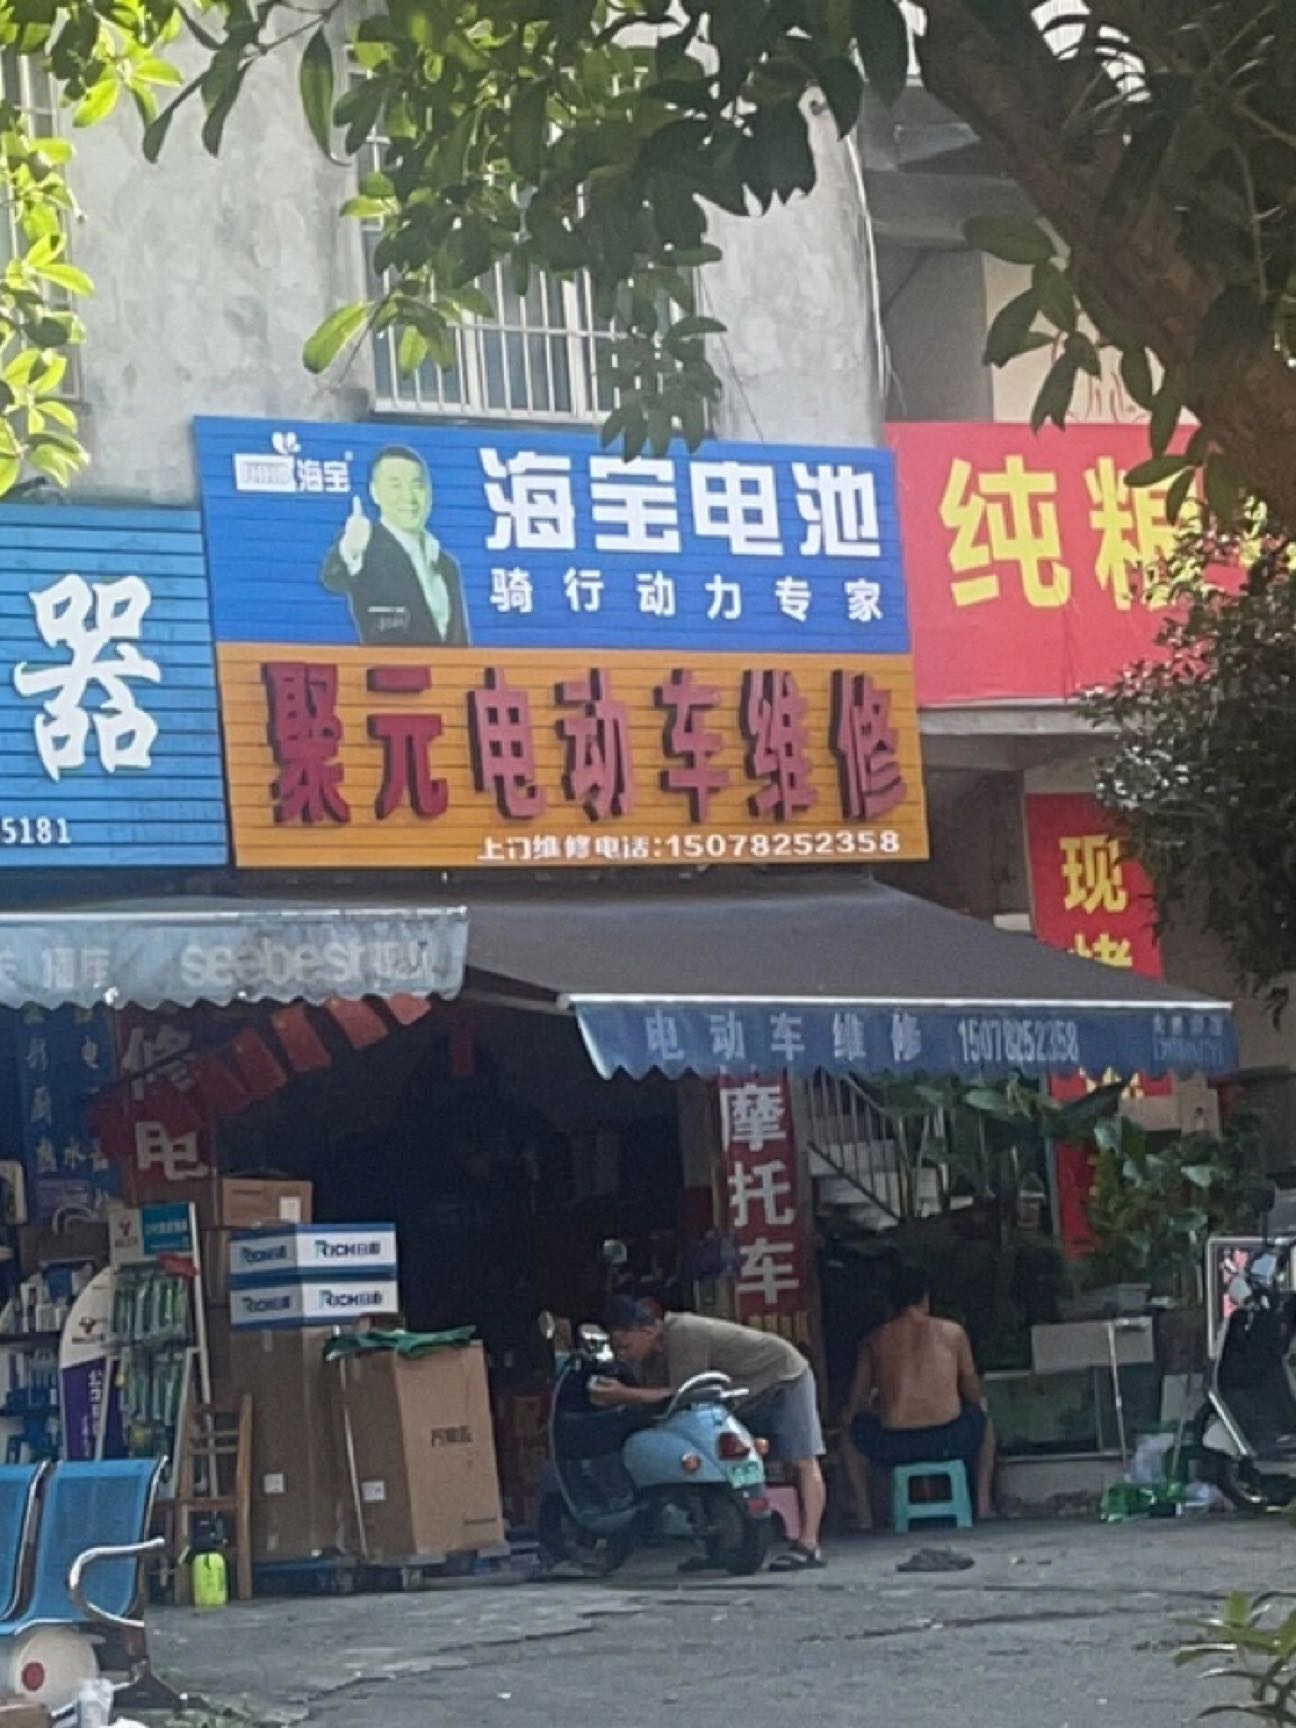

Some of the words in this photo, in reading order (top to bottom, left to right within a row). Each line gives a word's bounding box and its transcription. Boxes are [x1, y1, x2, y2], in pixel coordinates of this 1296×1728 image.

[478, 446, 882, 557] 海宝电池
[937, 453, 1296, 613] 纯粮
[489, 568, 884, 623] 骑行动力专家
[262, 660, 906, 824] 聚元电动车维修
[477, 829, 901, 862] 上门维修电话:15078252358
[644, 1011, 922, 1062] 电动车维修
[719, 1082, 802, 1306] 摩托车
